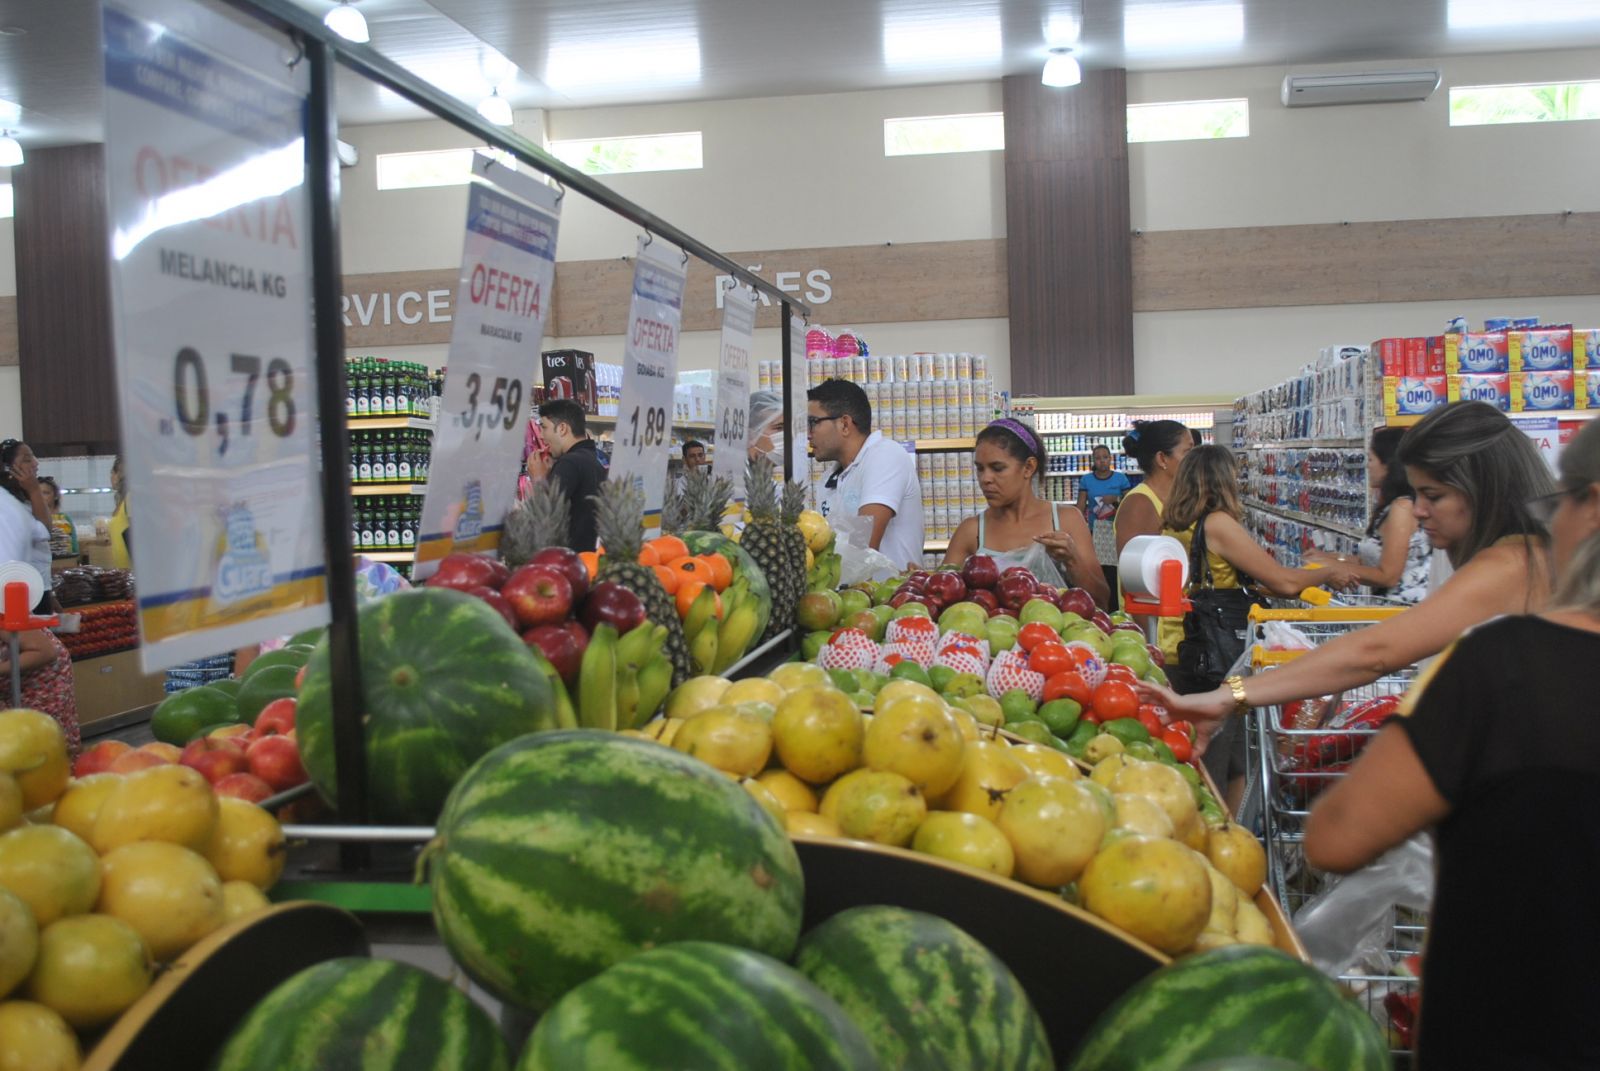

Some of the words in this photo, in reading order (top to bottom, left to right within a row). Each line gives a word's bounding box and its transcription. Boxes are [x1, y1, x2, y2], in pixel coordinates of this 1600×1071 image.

[160, 248, 256, 292] MELANCIA
[261, 273, 287, 298] KG
[470, 263, 540, 319] OFERTA
[633, 317, 674, 353] OFERTA
[723, 344, 748, 369] OFERTA
[1468, 348, 1494, 363] OMO
[1531, 346, 1557, 361] OMO
[174, 346, 296, 457] 0,78
[461, 372, 523, 441] 3,59
[1406, 390, 1432, 405] OMO
[1470, 388, 1496, 401] OMO
[1532, 386, 1558, 400] OMO
[630, 406, 666, 456] 1,89
[722, 407, 745, 447] 6,89
